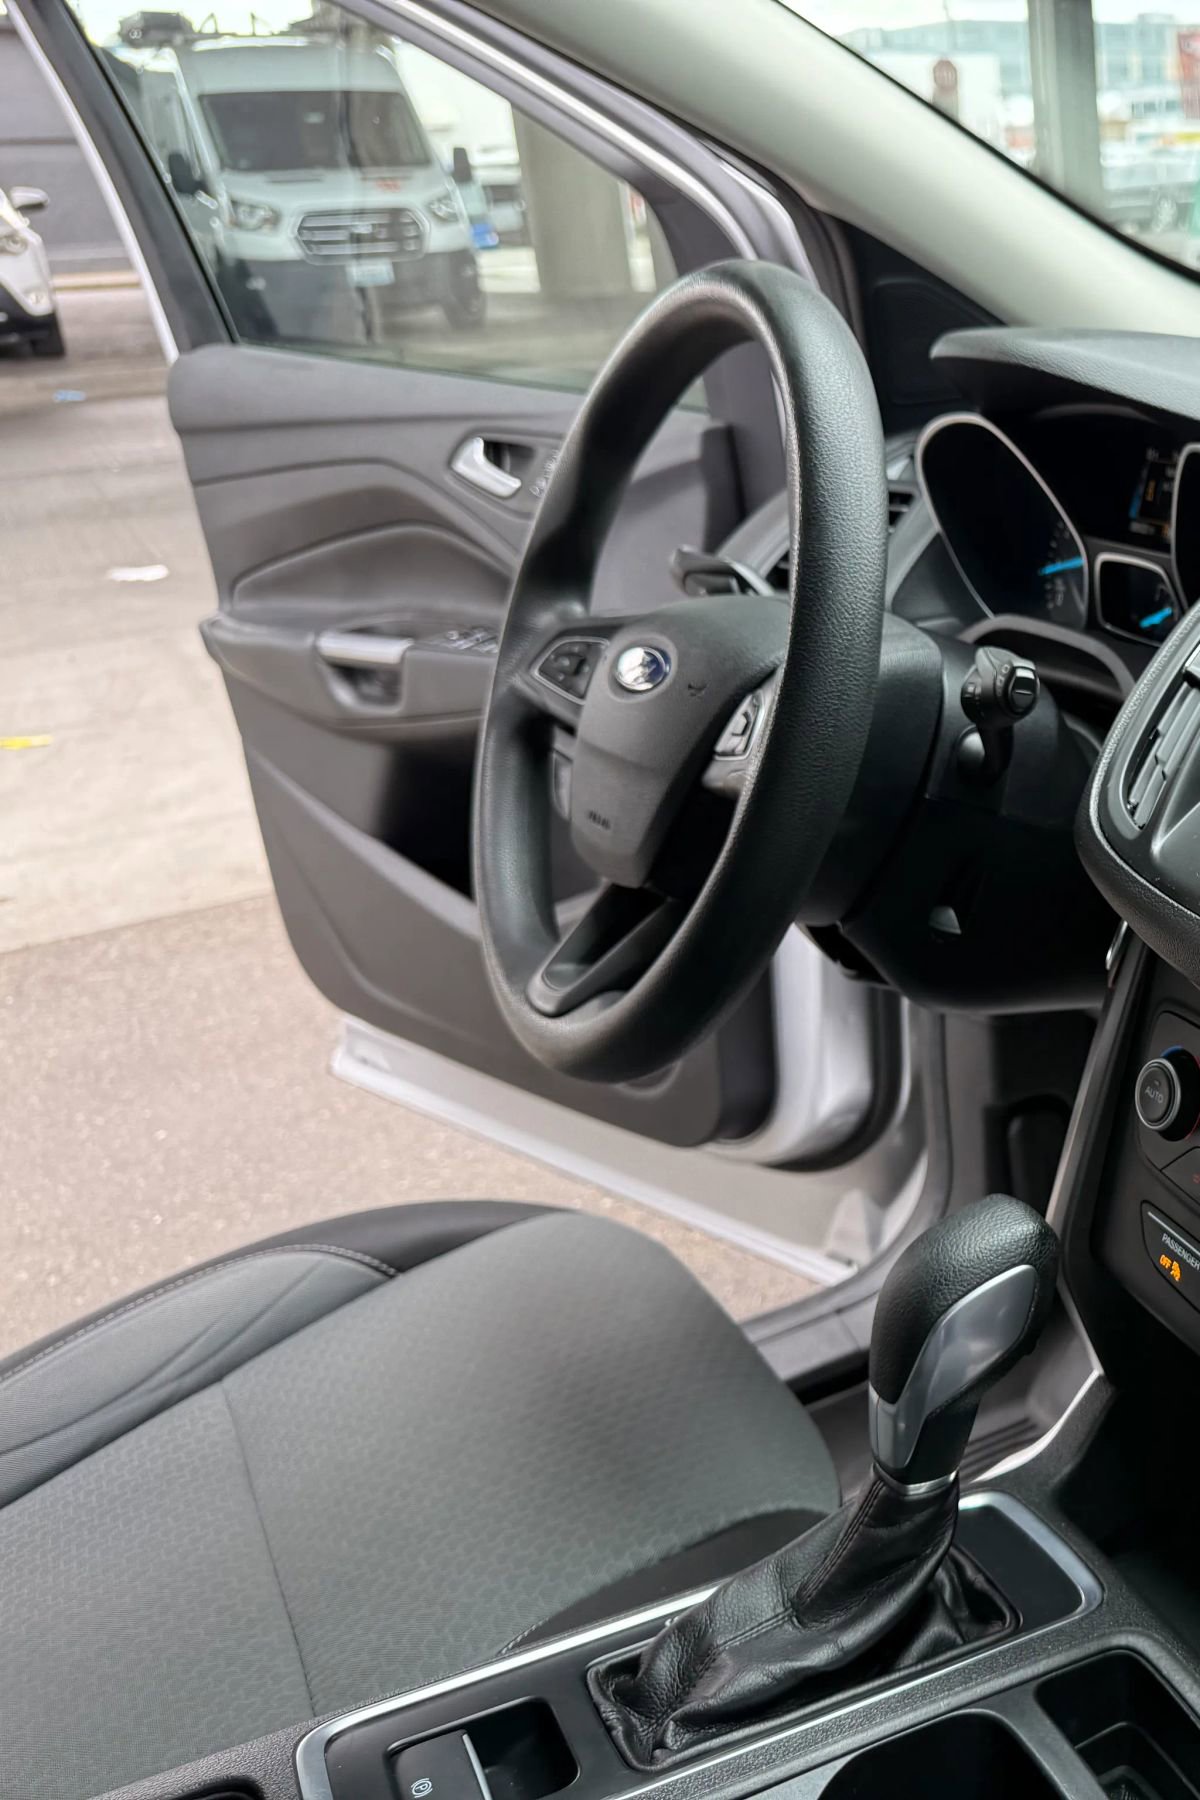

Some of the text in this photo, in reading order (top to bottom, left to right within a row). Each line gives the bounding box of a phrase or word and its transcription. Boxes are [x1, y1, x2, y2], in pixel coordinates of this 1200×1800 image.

[1144, 1085, 1164, 1104] AUTO
[1162, 1232, 1200, 1270] PASSENGER
[1160, 1254, 1172, 1269] OFF
